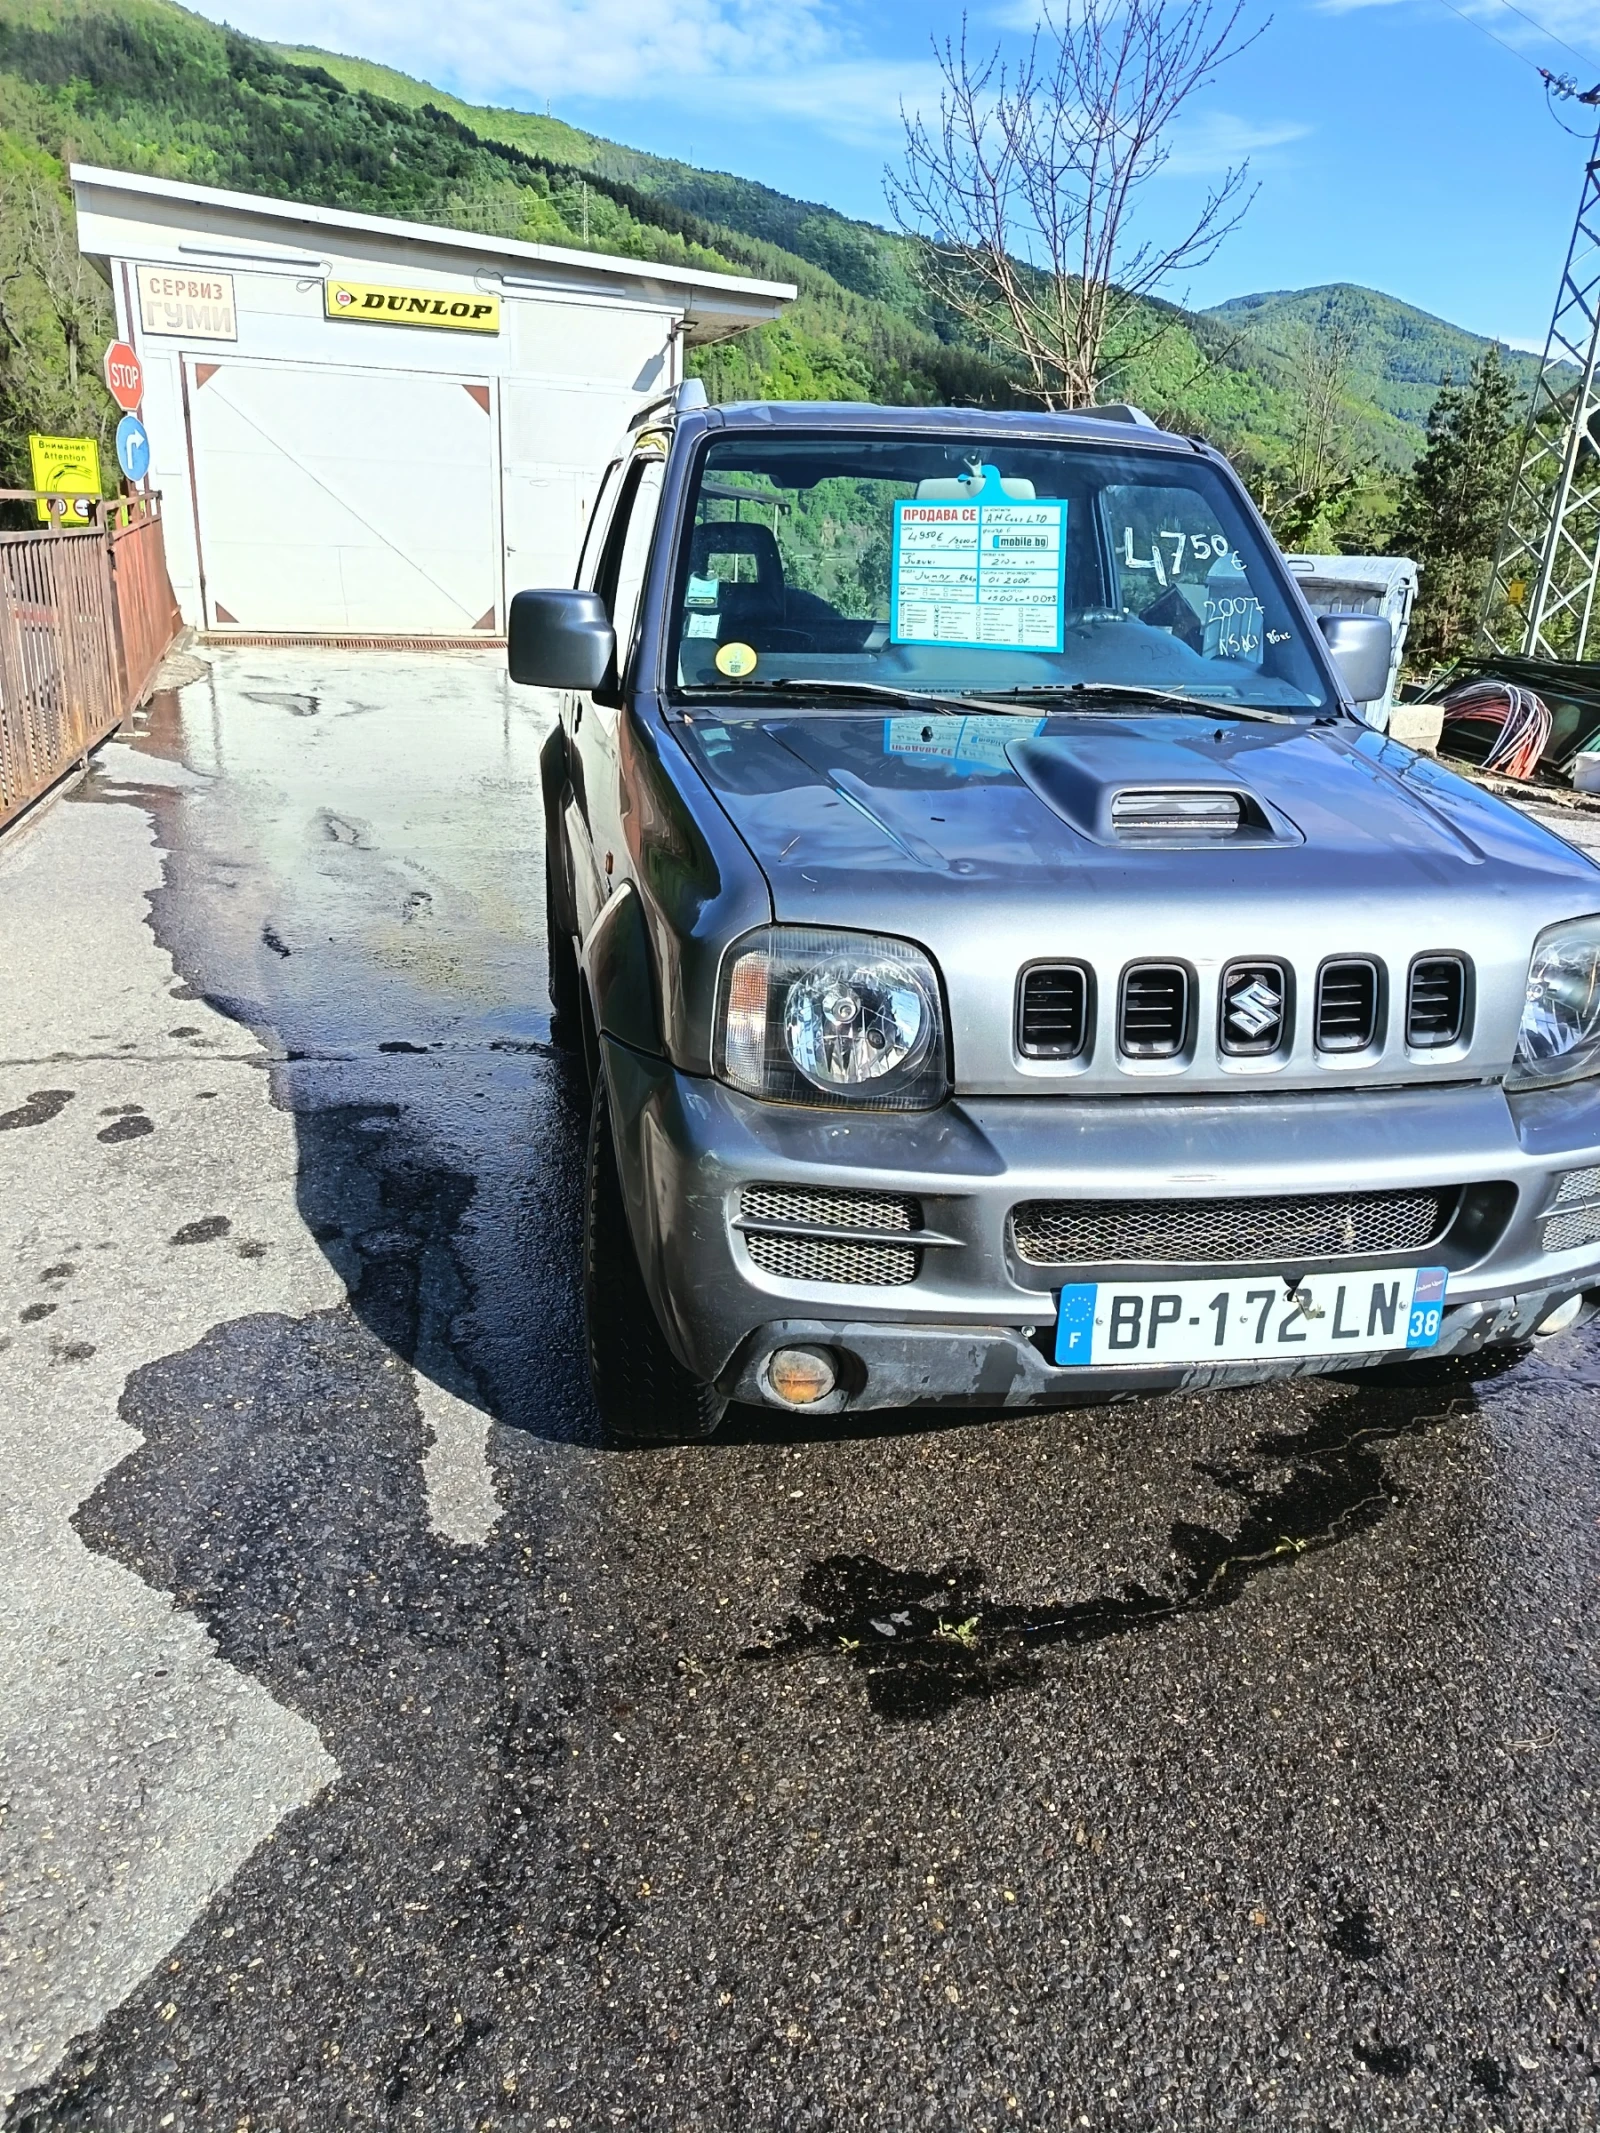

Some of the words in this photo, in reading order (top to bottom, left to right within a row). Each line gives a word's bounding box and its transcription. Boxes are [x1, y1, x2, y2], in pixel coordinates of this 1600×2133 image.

[149, 277, 223, 300] СЕРВИЗ
[146, 301, 231, 333] ГУМИ
[361, 293, 493, 319] DUNLOP
[111, 362, 139, 389] STOP
[38, 440, 90, 451] Внимание!
[44, 452, 86, 461] Attention
[903, 509, 958, 522] ПРОДАВА
[962, 509, 977, 521] СЕ
[1000, 537, 1046, 547] mobile.bg
[1204, 597, 1265, 622] 2007
[1108, 1281, 1400, 1349] BP-172-LN
[1410, 1309, 1440, 1338] 38
[1069, 1332, 1082, 1349] F
